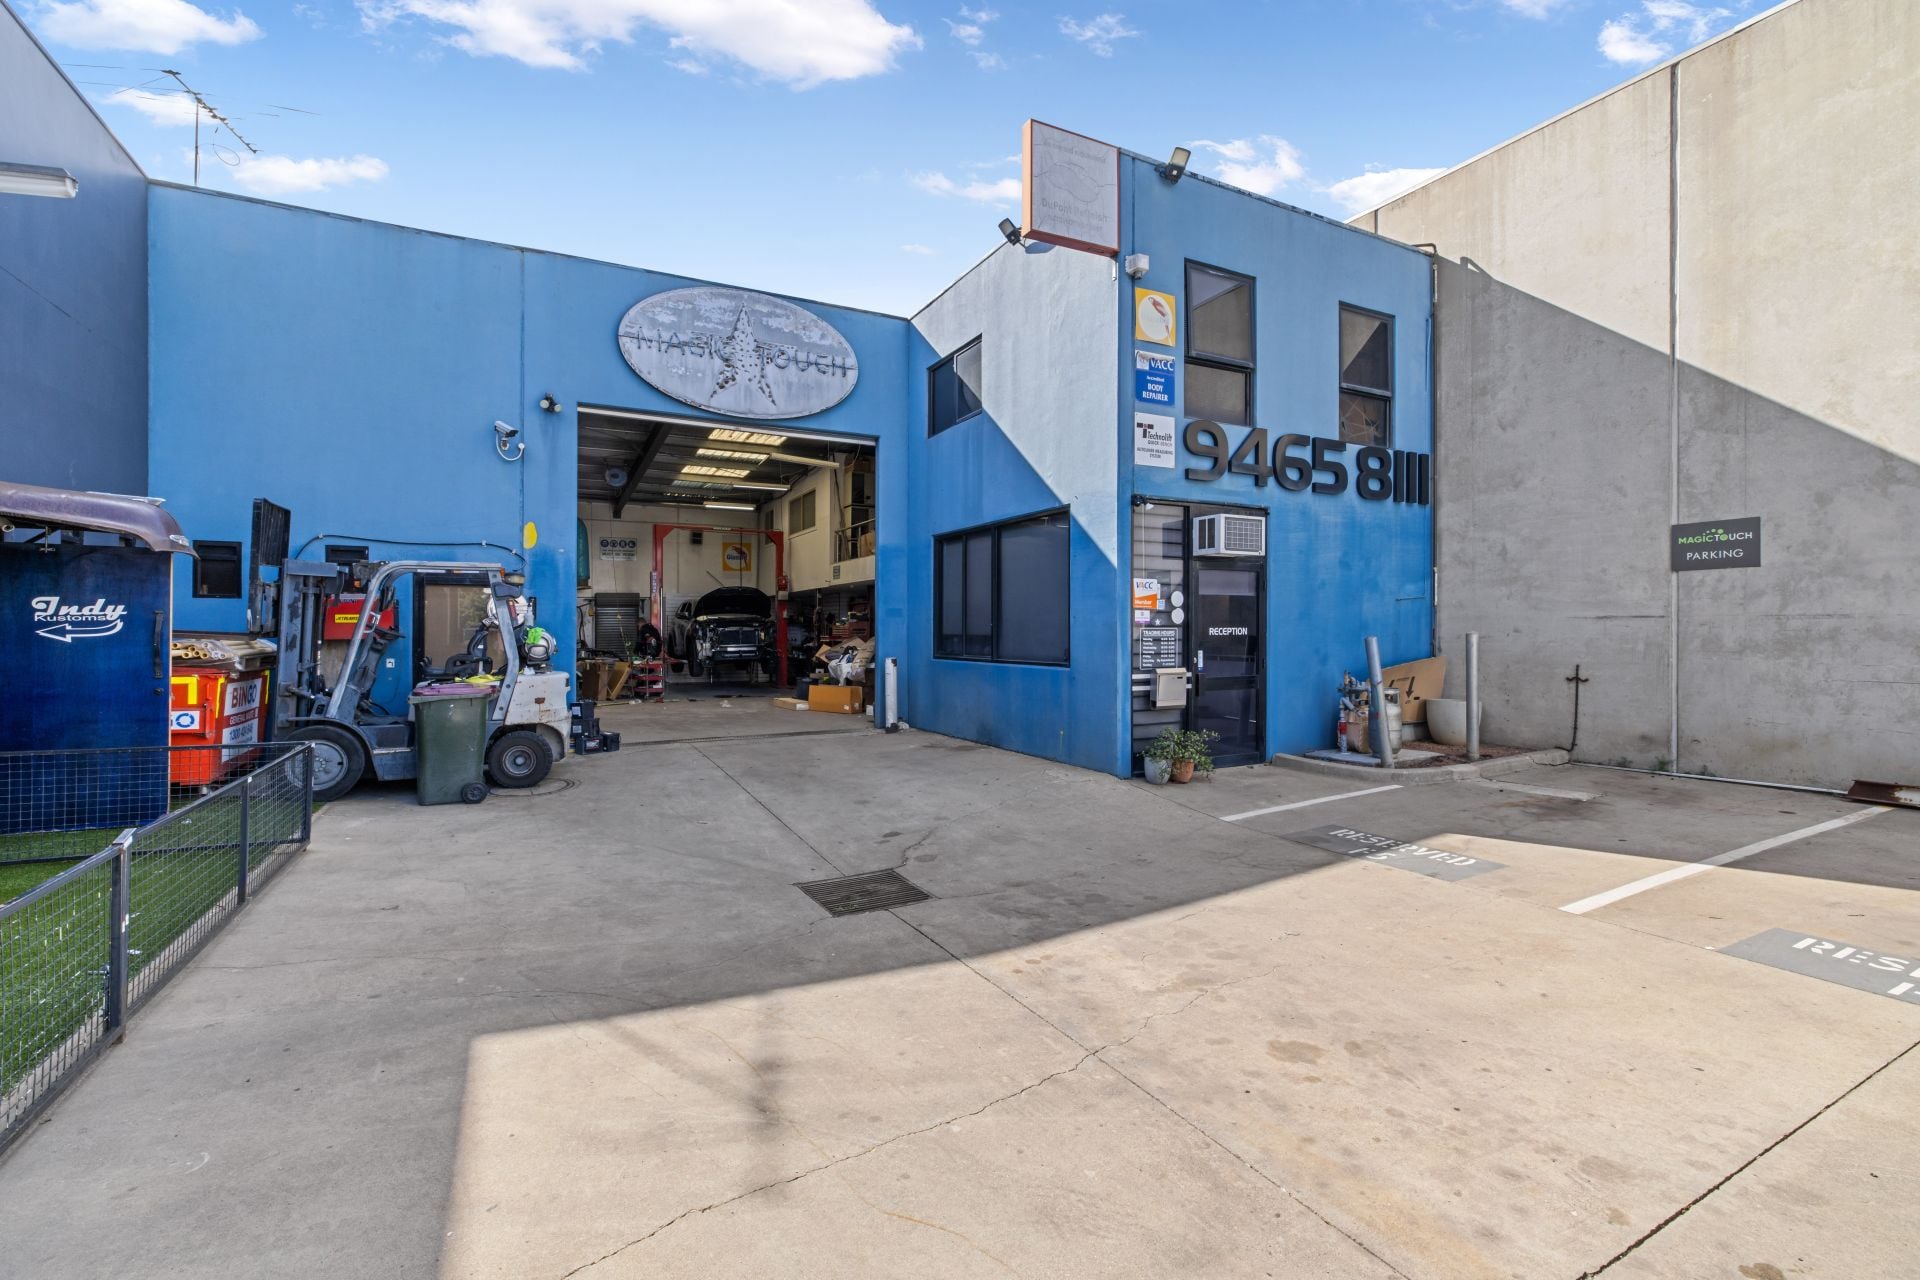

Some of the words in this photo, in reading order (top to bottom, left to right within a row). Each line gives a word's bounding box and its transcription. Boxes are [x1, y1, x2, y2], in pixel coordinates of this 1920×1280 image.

[1150, 358, 1174, 371] VACC
[1147, 383, 1164, 392] BODY
[1142, 391, 1169, 401] REPAIRER
[1183, 419, 1348, 495] 9465
[1686, 549, 1744, 561] PARKING
[31, 596, 128, 621] Indy
[34, 612, 106, 622] Kustoms
[1209, 627, 1248, 636] RECEPTION
[231, 684, 257, 708] BINGO
[1328, 829, 1477, 866] RESERVED
